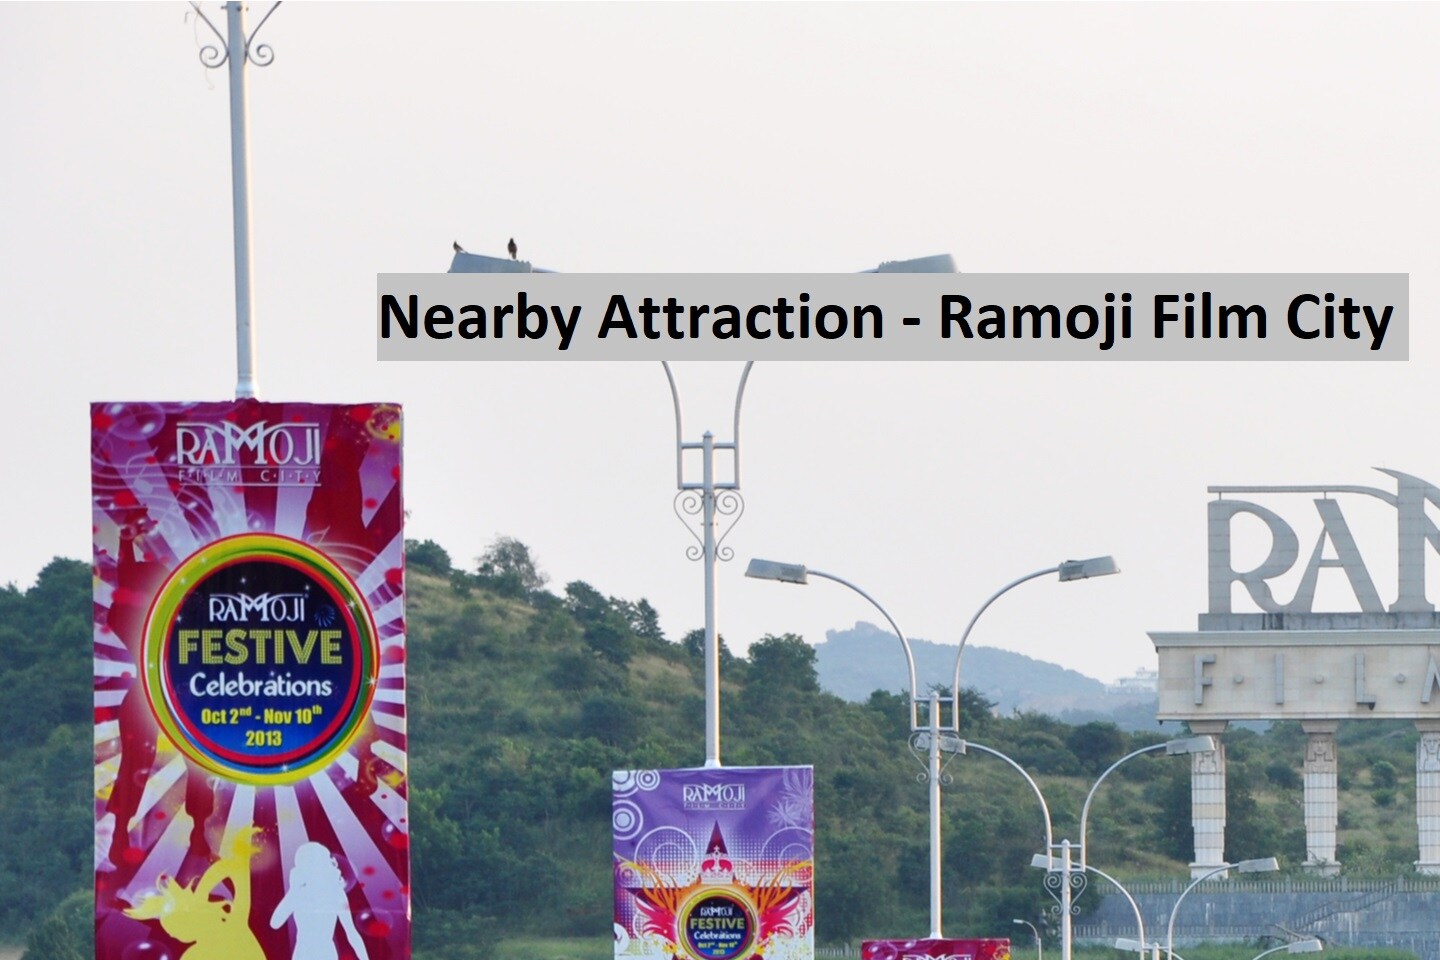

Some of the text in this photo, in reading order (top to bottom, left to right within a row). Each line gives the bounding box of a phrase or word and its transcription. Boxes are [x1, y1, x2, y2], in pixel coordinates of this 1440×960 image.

[176, 420, 321, 465] RAMOJI
[209, 592, 305, 622] RAMOJI
[178, 629, 343, 665] FESTIVE
[189, 671, 333, 697] Celebrations
[201, 708, 227, 724] Oct
[229, 706, 252, 724] 2nd
[263, 708, 292, 724] Nov
[295, 705, 322, 724] 10th
[245, 730, 283, 746] 2013
[683, 783, 745, 802] RAMOJI
[690, 918, 745, 929] FESTIVE
[693, 931, 741, 939] Celebrations
